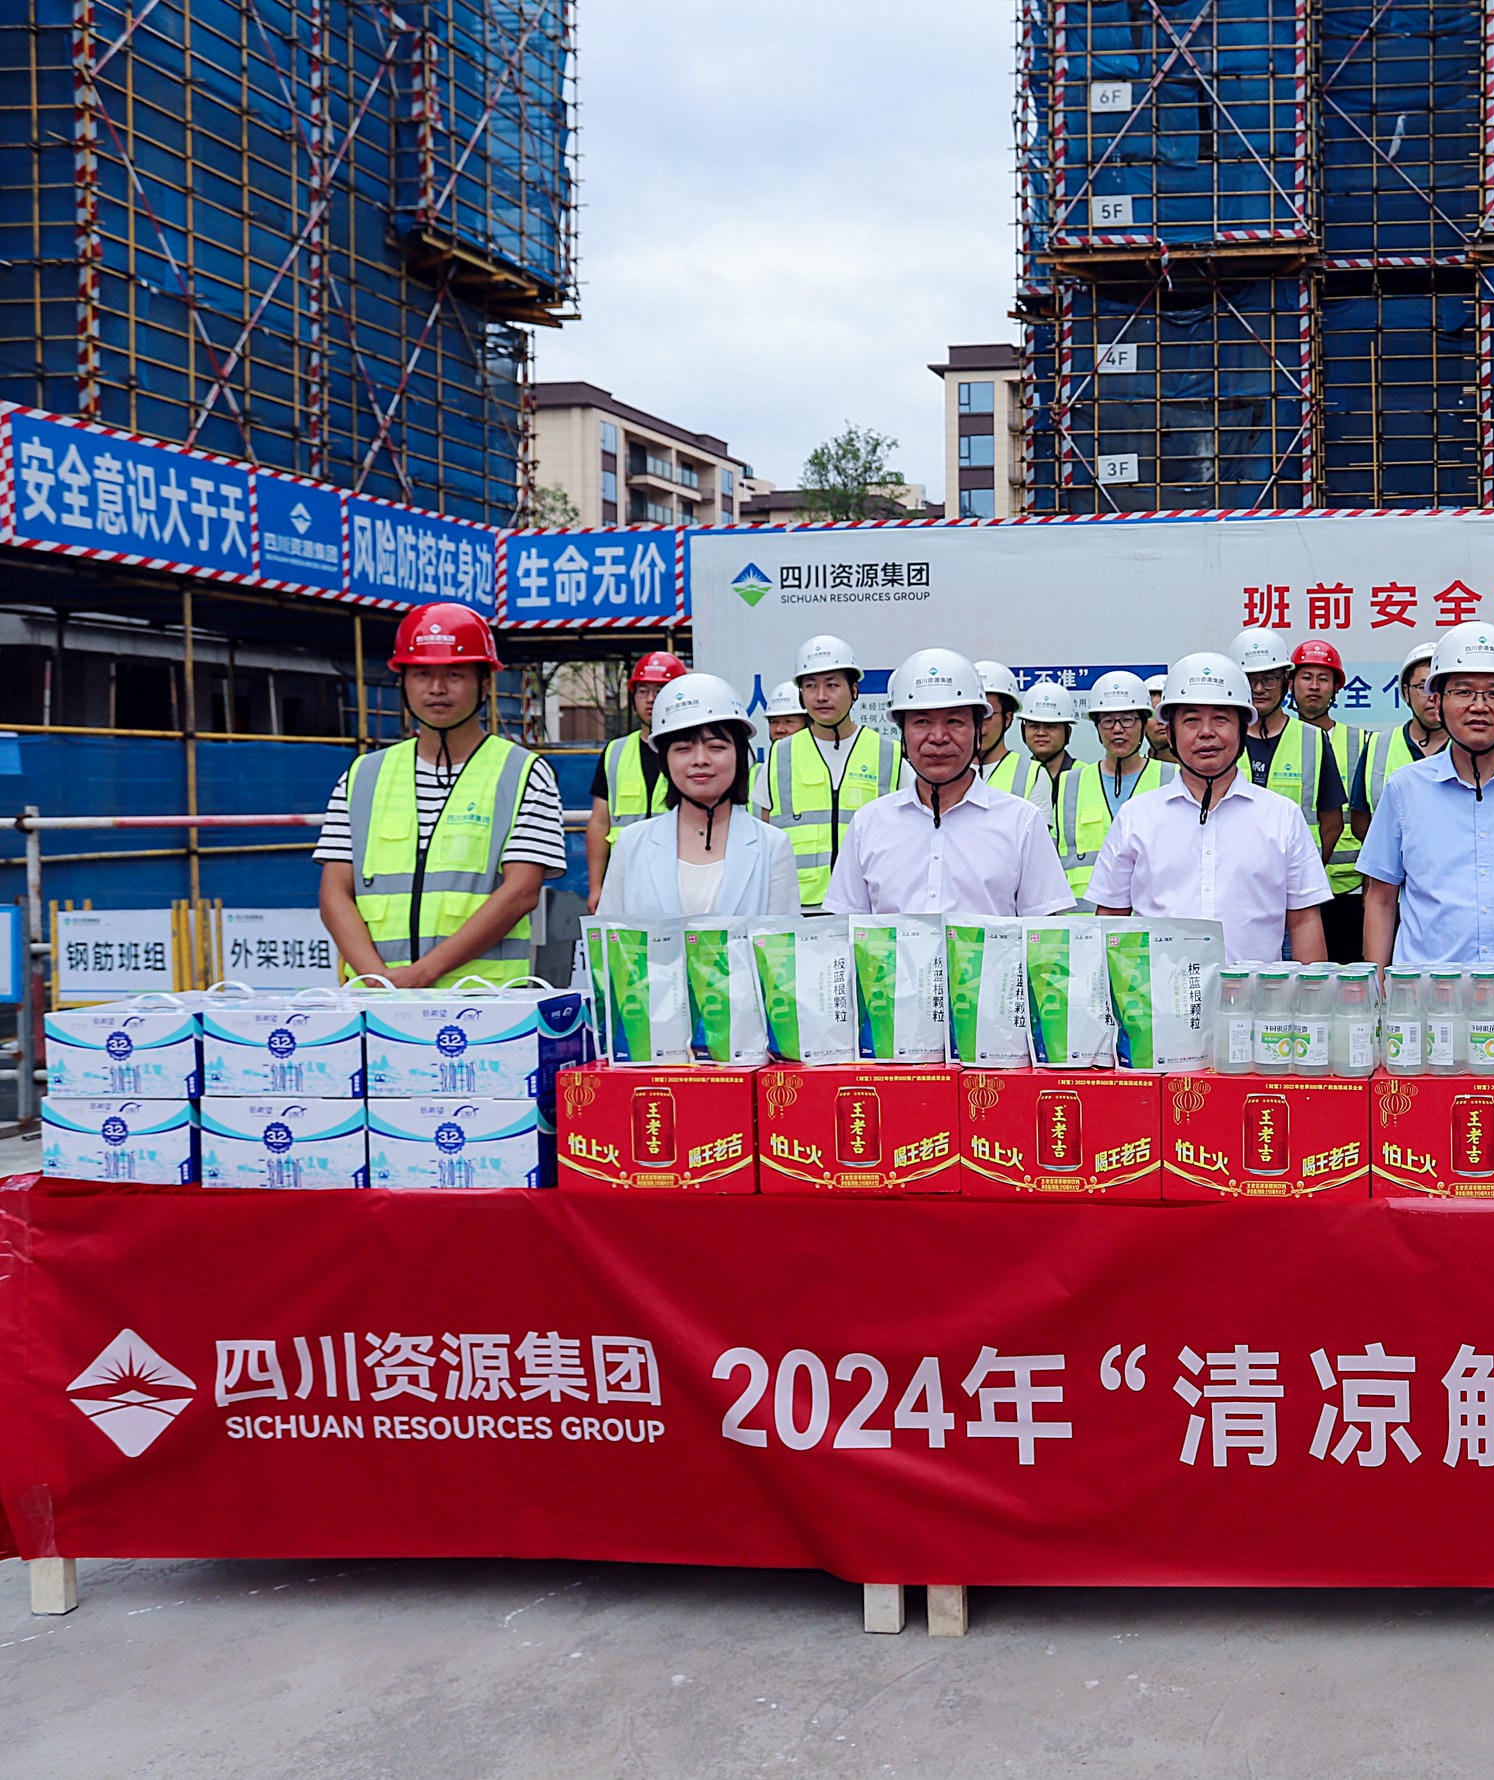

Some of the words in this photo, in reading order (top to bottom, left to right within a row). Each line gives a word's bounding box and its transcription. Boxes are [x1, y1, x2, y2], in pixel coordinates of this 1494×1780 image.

[1100, 88, 1122, 103] 6F
[1102, 205, 1123, 219] 5F
[1106, 352, 1128, 366] 4F
[1107, 462, 1129, 476] 3F
[20, 436, 248, 558] 安全意识大于天
[352, 516, 494, 606] 风险防控在身边
[516, 543, 666, 607] 生命无价
[780, 562, 930, 590] 四川资源集团
[780, 594, 827, 604] SICHUAN
[830, 593, 891, 603] RESOURCES
[893, 591, 931, 602] GROUP
[916, 677, 952, 686] 四川资源集团
[1189, 677, 1224, 685] 四川资源集团
[67, 941, 167, 972] 钢筋班组
[230, 938, 332, 970] 外架班组
[833, 958, 847, 1023] 板蓝根颗粒
[1188, 963, 1201, 1029] 板蓝根颗粒
[646, 1102, 661, 1154] 王老吉
[850, 1103, 866, 1154] 王老吉
[1051, 1106, 1067, 1158] 王老吉
[1258, 1110, 1275, 1163] 王老吉
[1466, 1111, 1483, 1164] 王老吉
[568, 1132, 620, 1168] 怕上火
[689, 1133, 743, 1168] 喝王老吉
[770, 1133, 823, 1168] 怕上火
[894, 1132, 950, 1168] 喝王老吉
[971, 1135, 1024, 1171] 怕上火
[1095, 1137, 1152, 1173] 喝王老吉
[1176, 1138, 1230, 1175] 怕上火
[1303, 1141, 1360, 1178] 喝王老吉
[1382, 1142, 1437, 1178] 怕上火
[214, 1332, 662, 1407] 四川资源集团
[226, 1415, 364, 1438] SICHUAN
[373, 1416, 553, 1441] RESOURCES
[560, 1418, 665, 1443] GROUP
